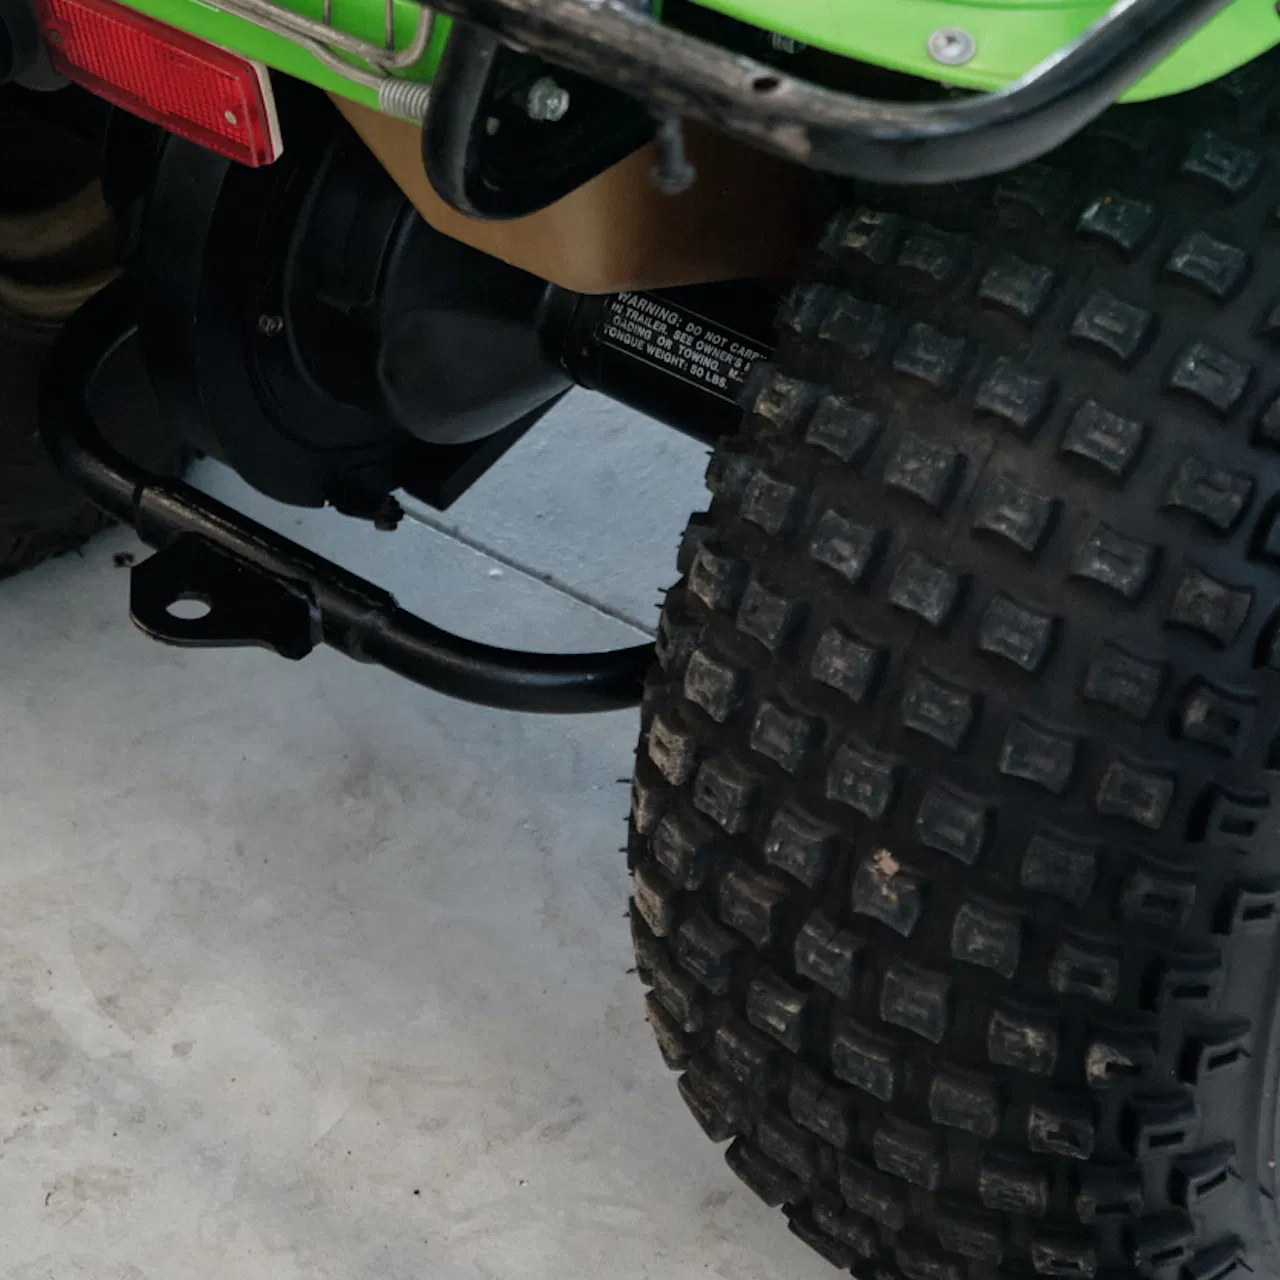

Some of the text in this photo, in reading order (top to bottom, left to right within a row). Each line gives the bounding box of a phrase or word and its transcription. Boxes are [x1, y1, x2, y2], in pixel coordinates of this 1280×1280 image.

[610, 301, 624, 314] IN
[625, 306, 669, 336] TRAILER.
[673, 329, 695, 347] SEE
[695, 339, 743, 369] OWNER'S
[612, 314, 653, 340] OADING
[656, 335, 673, 351] OR
[677, 344, 720, 373] TOWING.
[617, 291, 683, 328] WARNING:
[685, 322, 703, 337] DO
[703, 331, 728, 348] NOT
[603, 323, 646, 351] TONGUE
[646, 342, 689, 371] WEIGHT:
[689, 363, 704, 379] 50
[705, 370, 729, 391] LBS.
